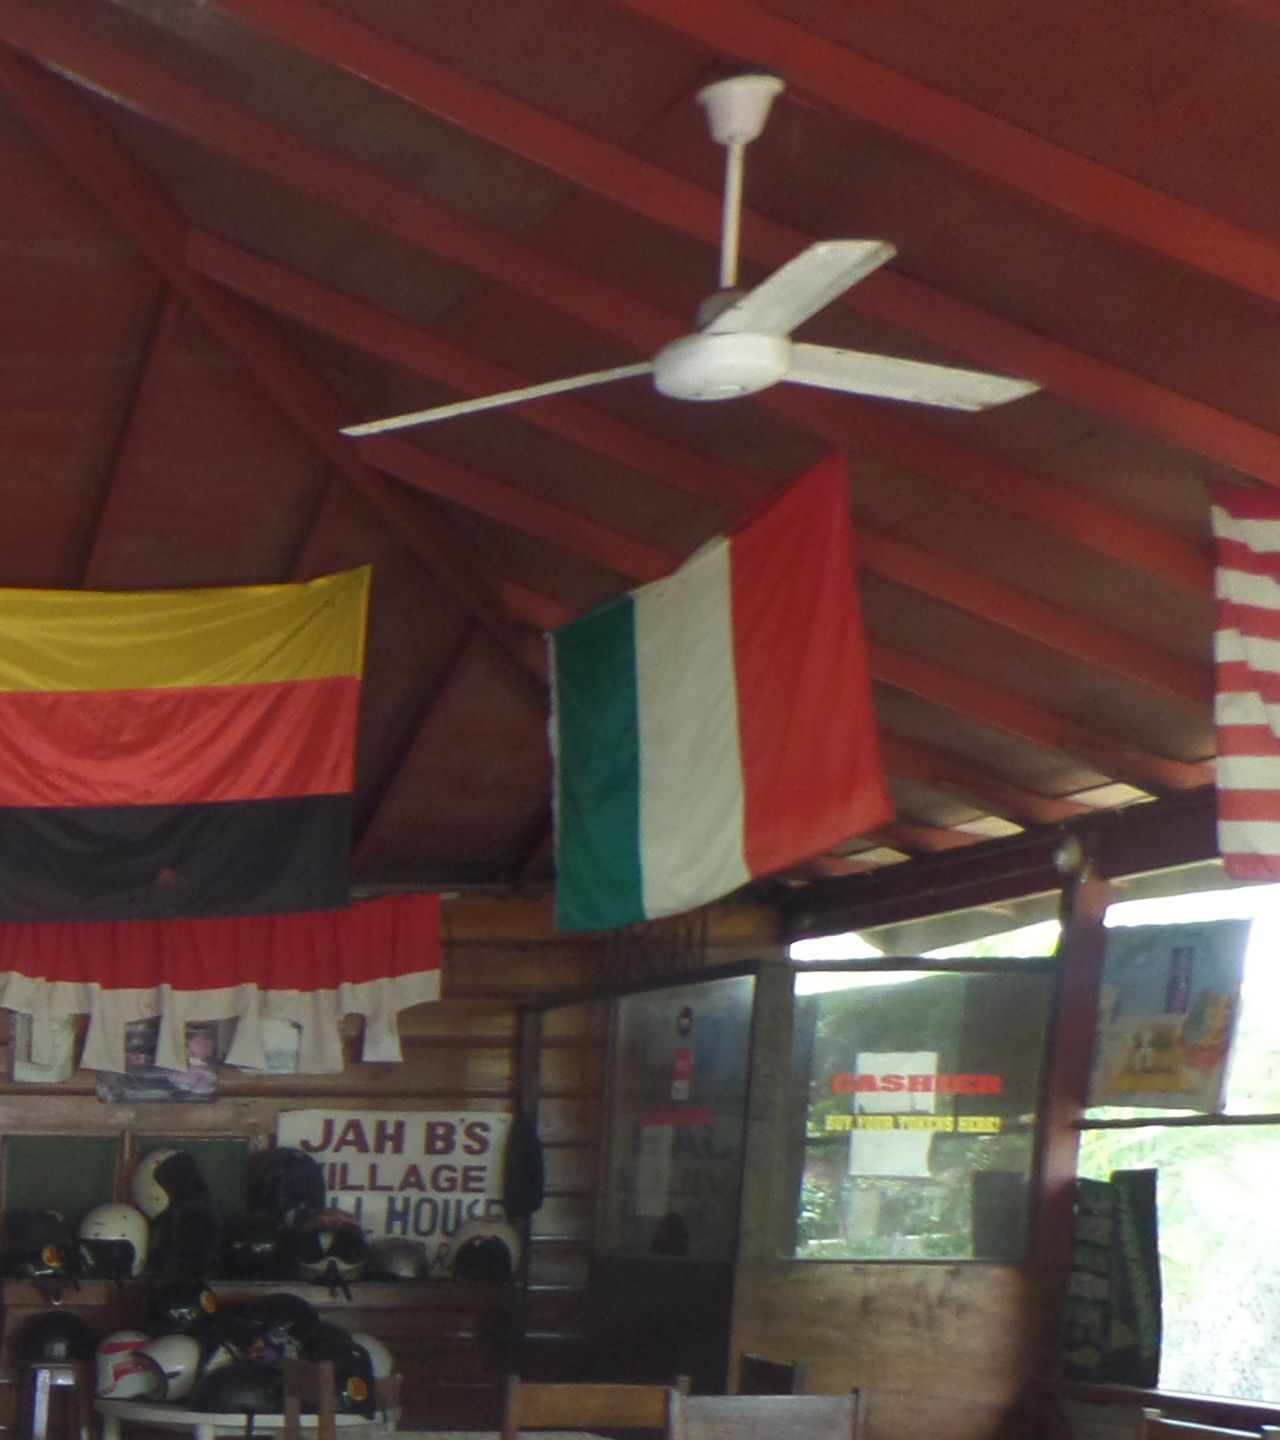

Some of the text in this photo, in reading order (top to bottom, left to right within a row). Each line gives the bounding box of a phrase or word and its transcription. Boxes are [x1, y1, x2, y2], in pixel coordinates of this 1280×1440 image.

[300, 1118, 491, 1156] JAH B'S
[321, 1162, 487, 1194] ILLAGE
